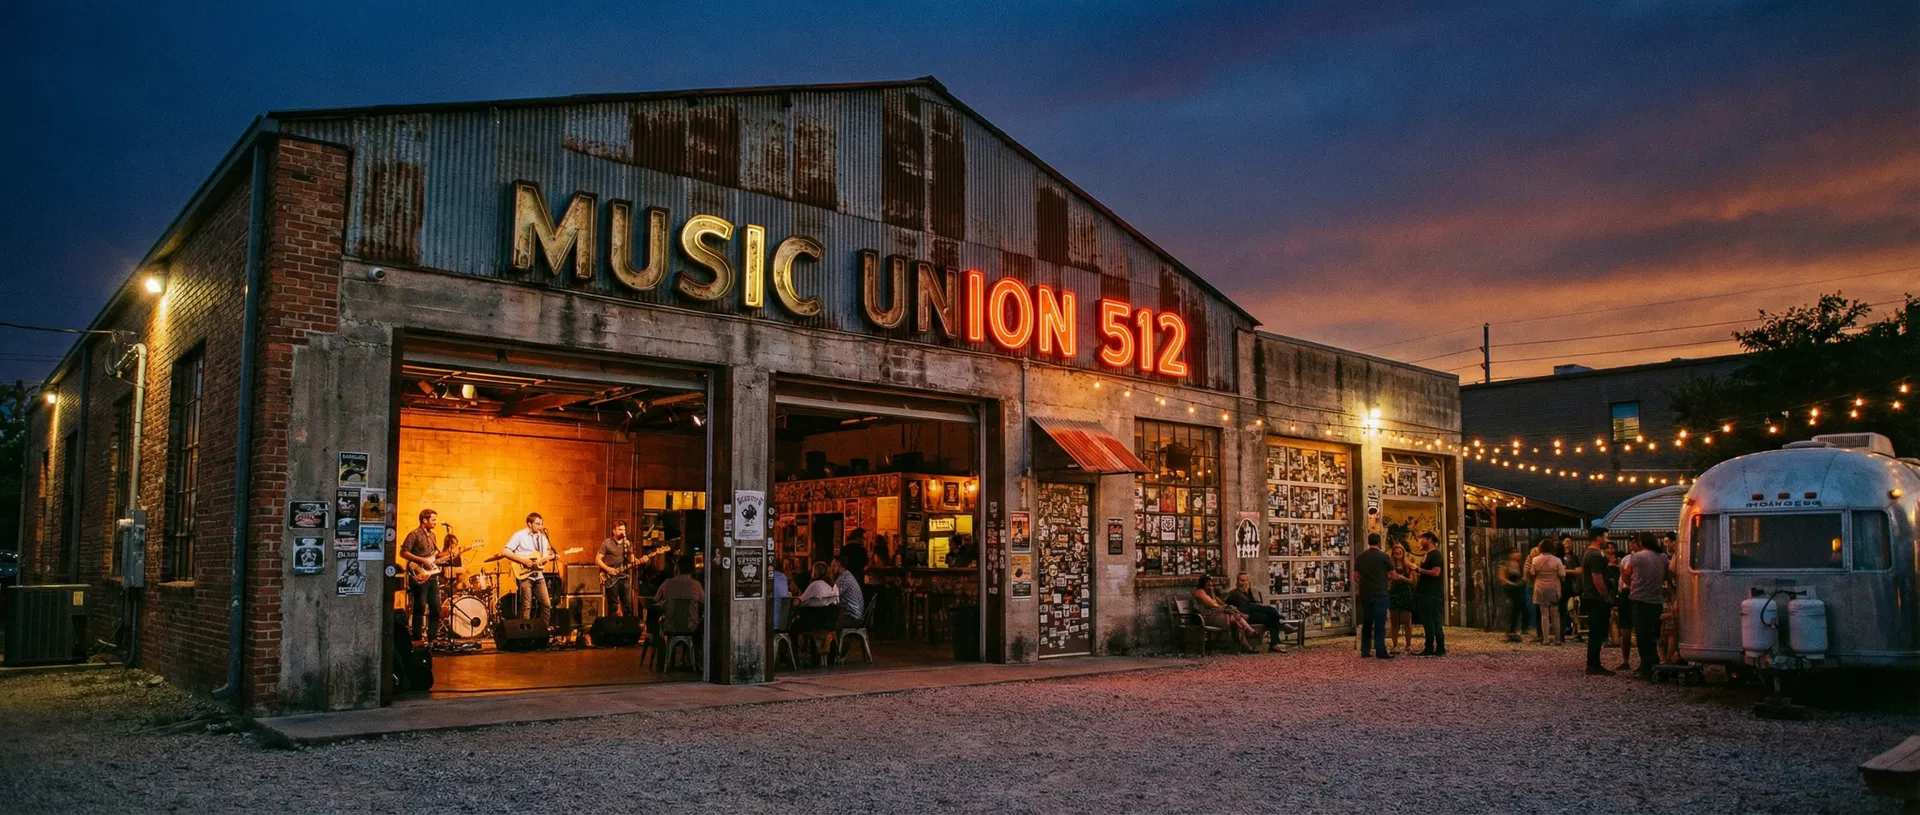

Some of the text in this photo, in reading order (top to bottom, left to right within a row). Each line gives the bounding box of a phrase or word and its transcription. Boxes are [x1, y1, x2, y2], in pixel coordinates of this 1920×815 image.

[511, 179, 1188, 377] MUSIC UNION 512
